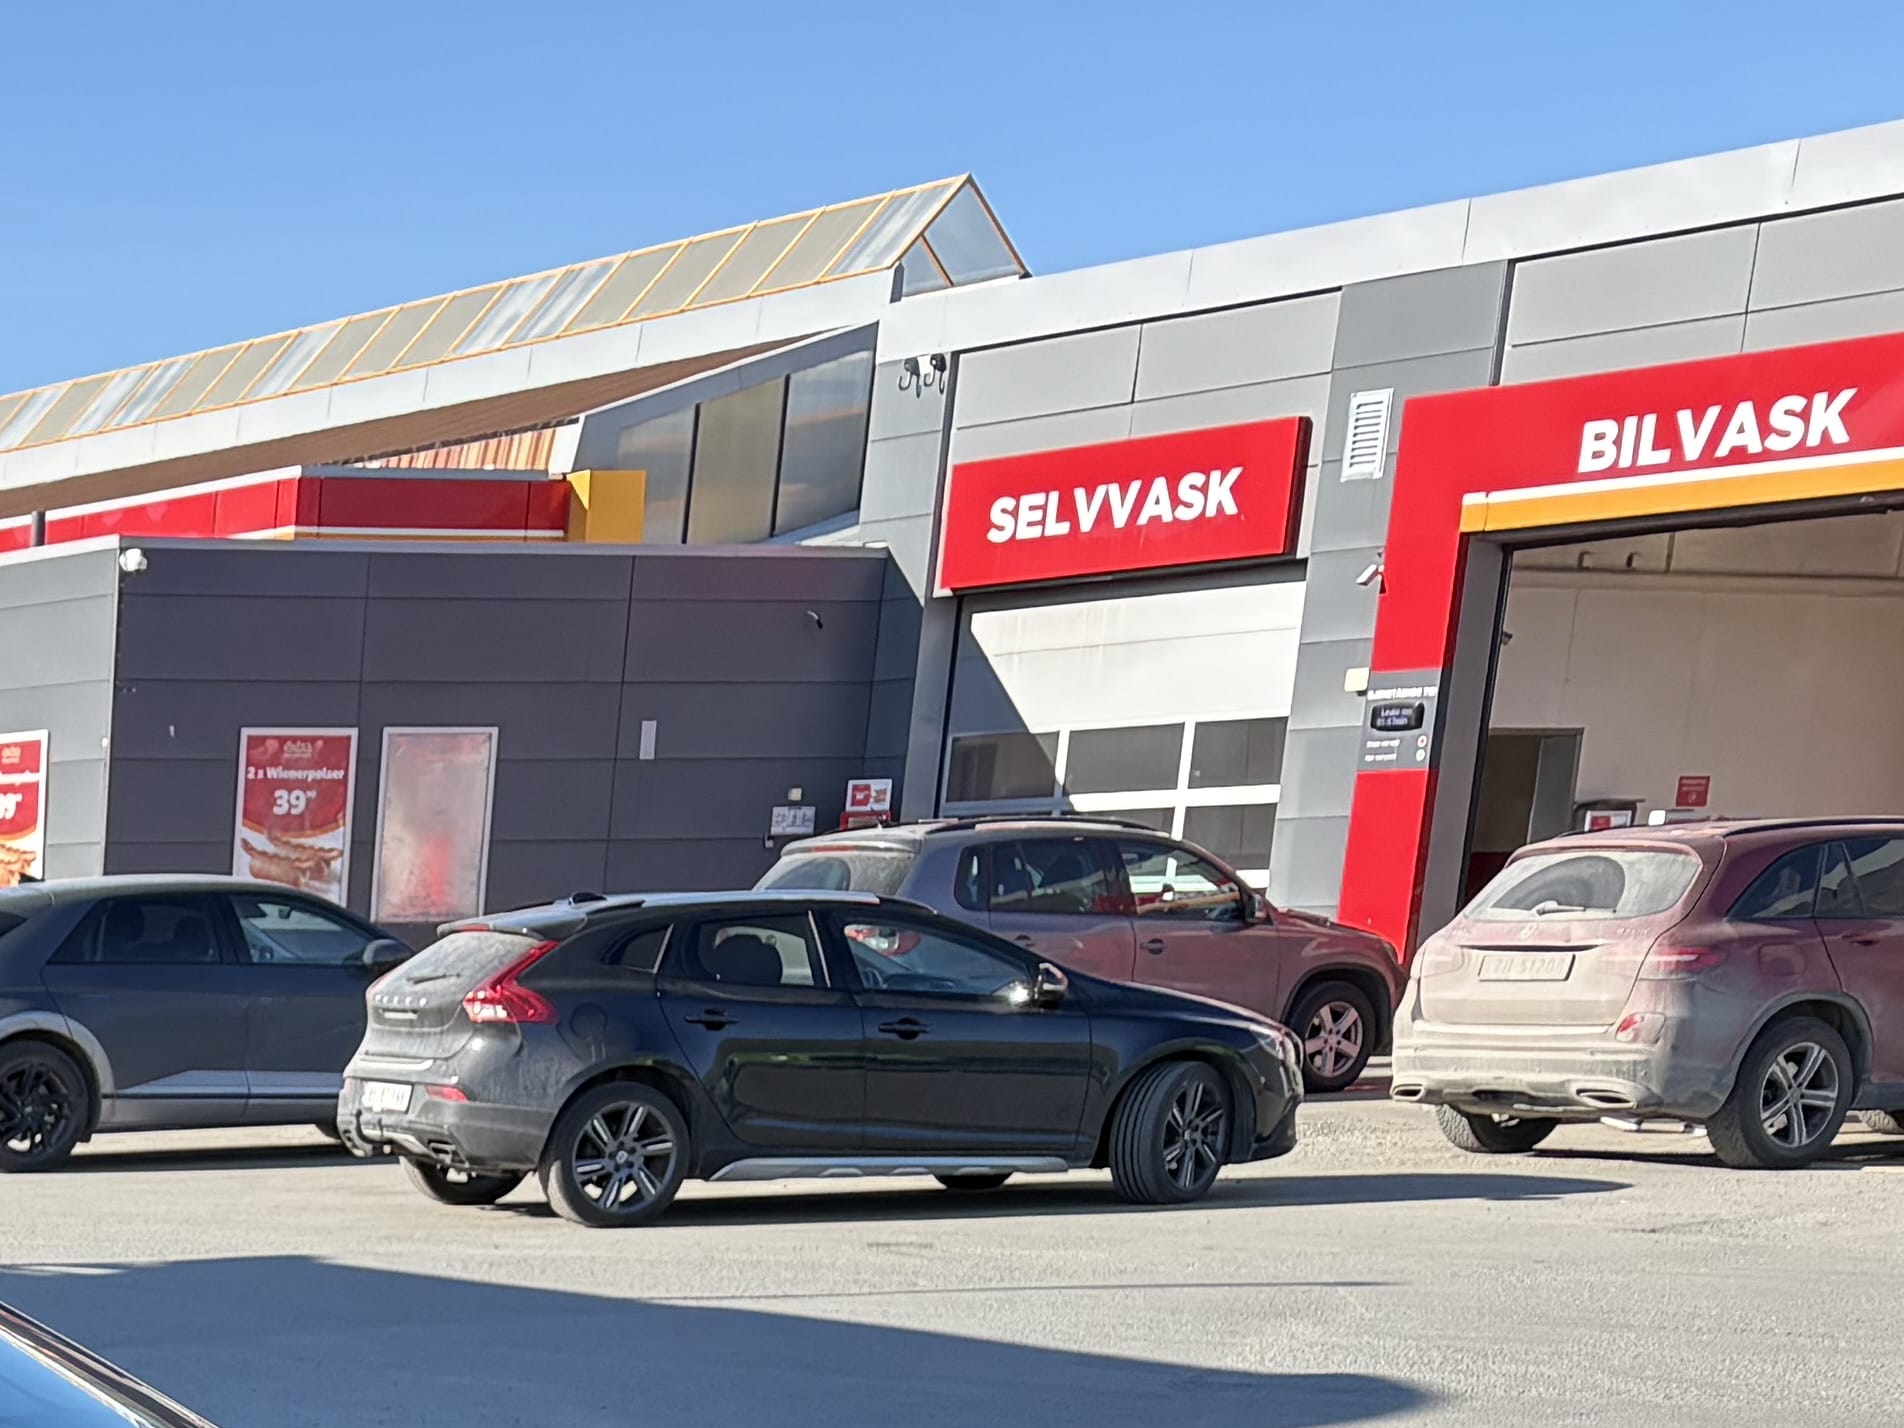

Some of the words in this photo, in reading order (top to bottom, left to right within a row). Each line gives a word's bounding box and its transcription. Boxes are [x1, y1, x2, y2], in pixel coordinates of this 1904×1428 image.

[1577, 387, 1858, 473] BILVASK
[986, 466, 1244, 543] SELVVASK
[273, 788, 307, 815] 39
